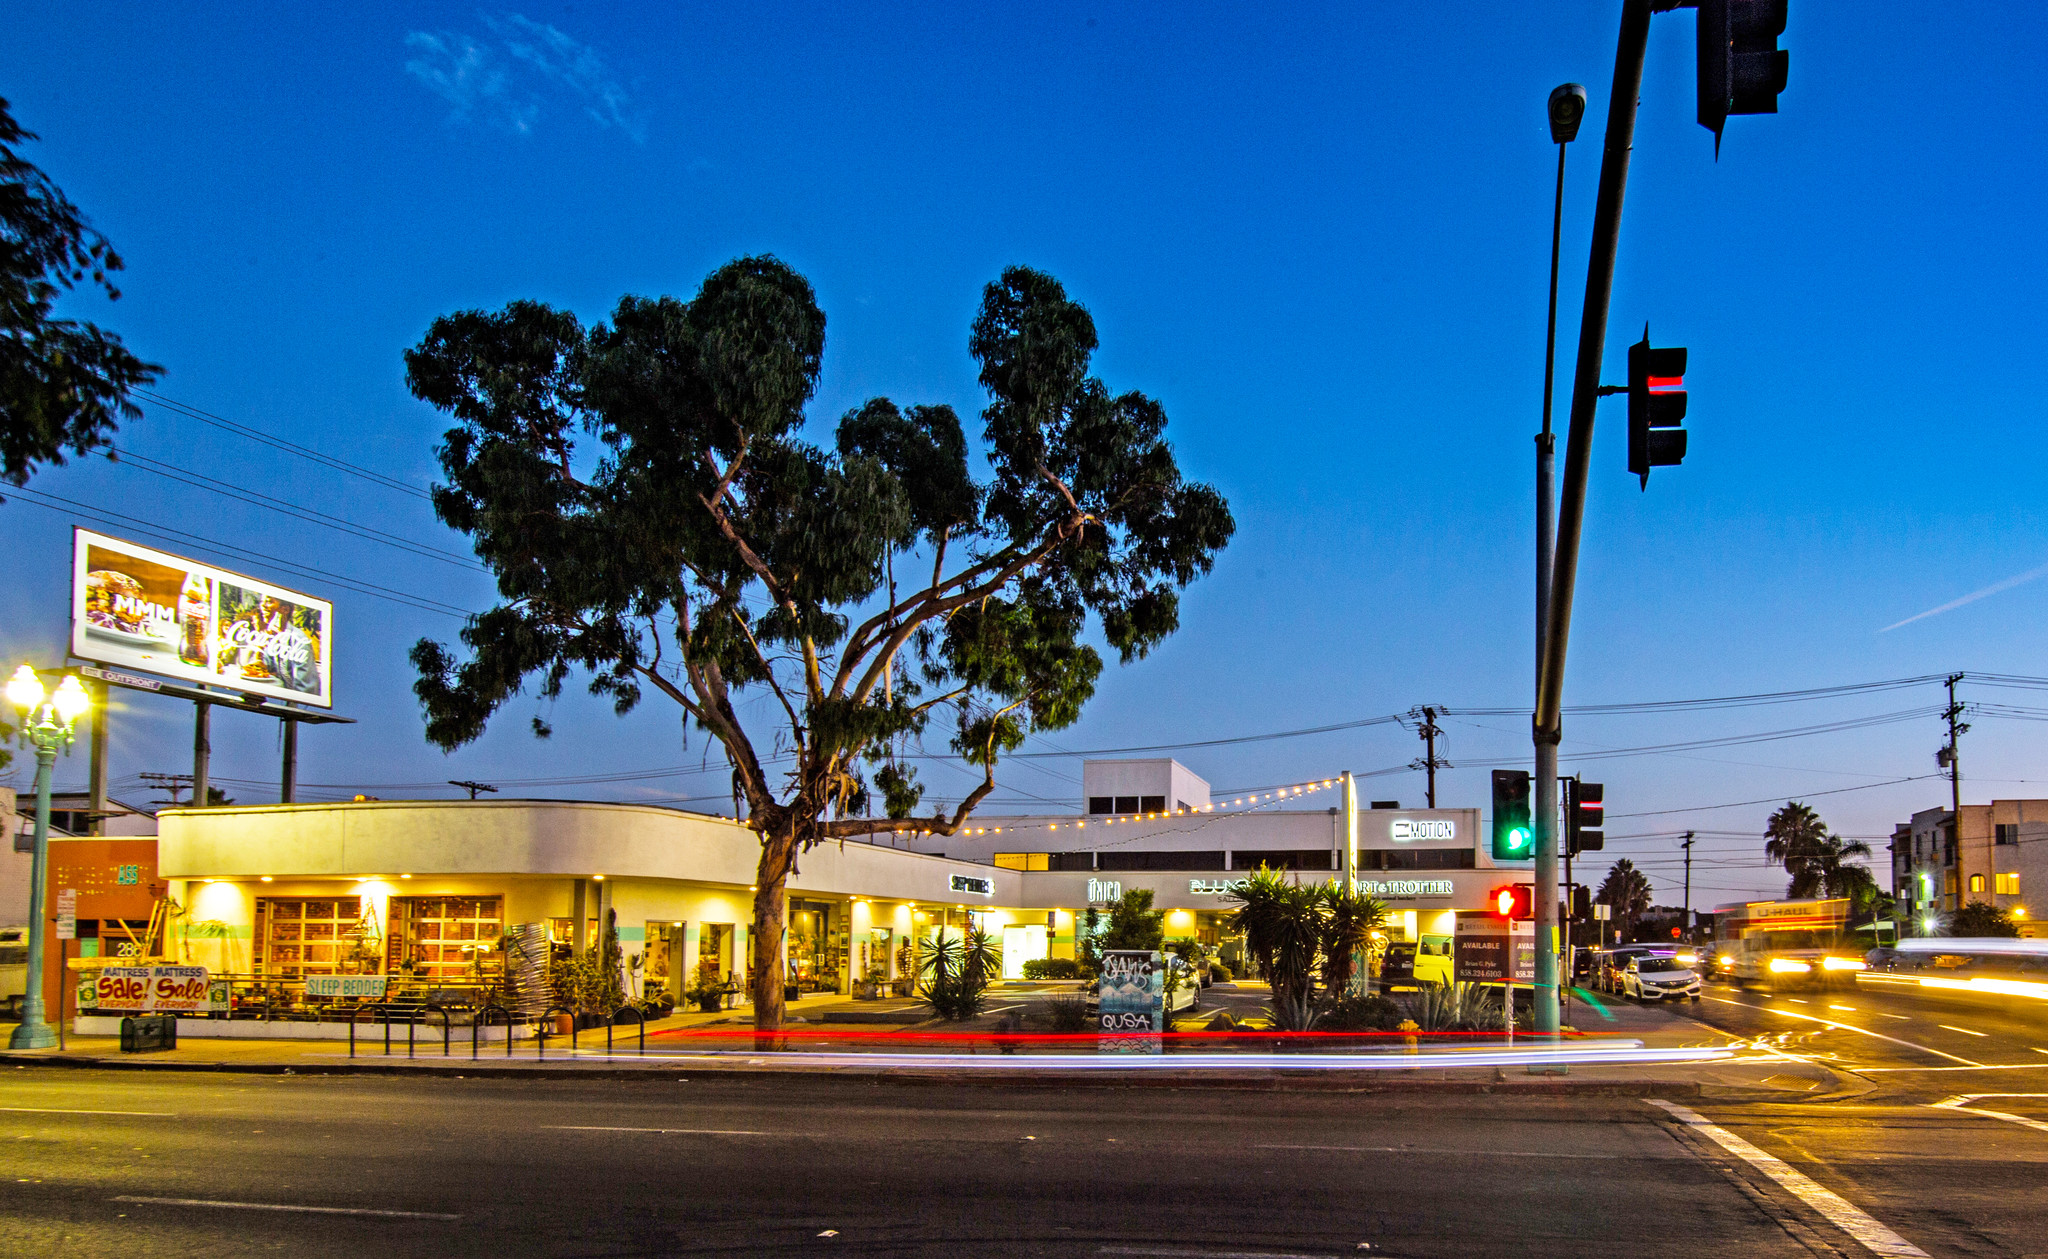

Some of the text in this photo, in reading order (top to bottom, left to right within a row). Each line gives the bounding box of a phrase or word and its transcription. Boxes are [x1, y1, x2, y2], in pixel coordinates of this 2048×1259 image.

[115, 593, 175, 624] MMM
[222, 620, 311, 663] Coca-Cola
[106, 672, 155, 688] OUTFRONT
[1387, 881, 1453, 894] TROTTER
[1756, 907, 1812, 918] U-HAUL
[1462, 942, 1501, 950] AVAILABLE
[1516, 942, 1535, 950] AVAIL
[103, 967, 203, 977] MATTRESS MATTRESS
[1460, 969, 1502, 978] 858.324.6103
[1515, 970, 1535, 978] 858.32
[98, 976, 212, 1001] Sale! Sale!
[308, 978, 385, 995] SLEEP BEDDER
